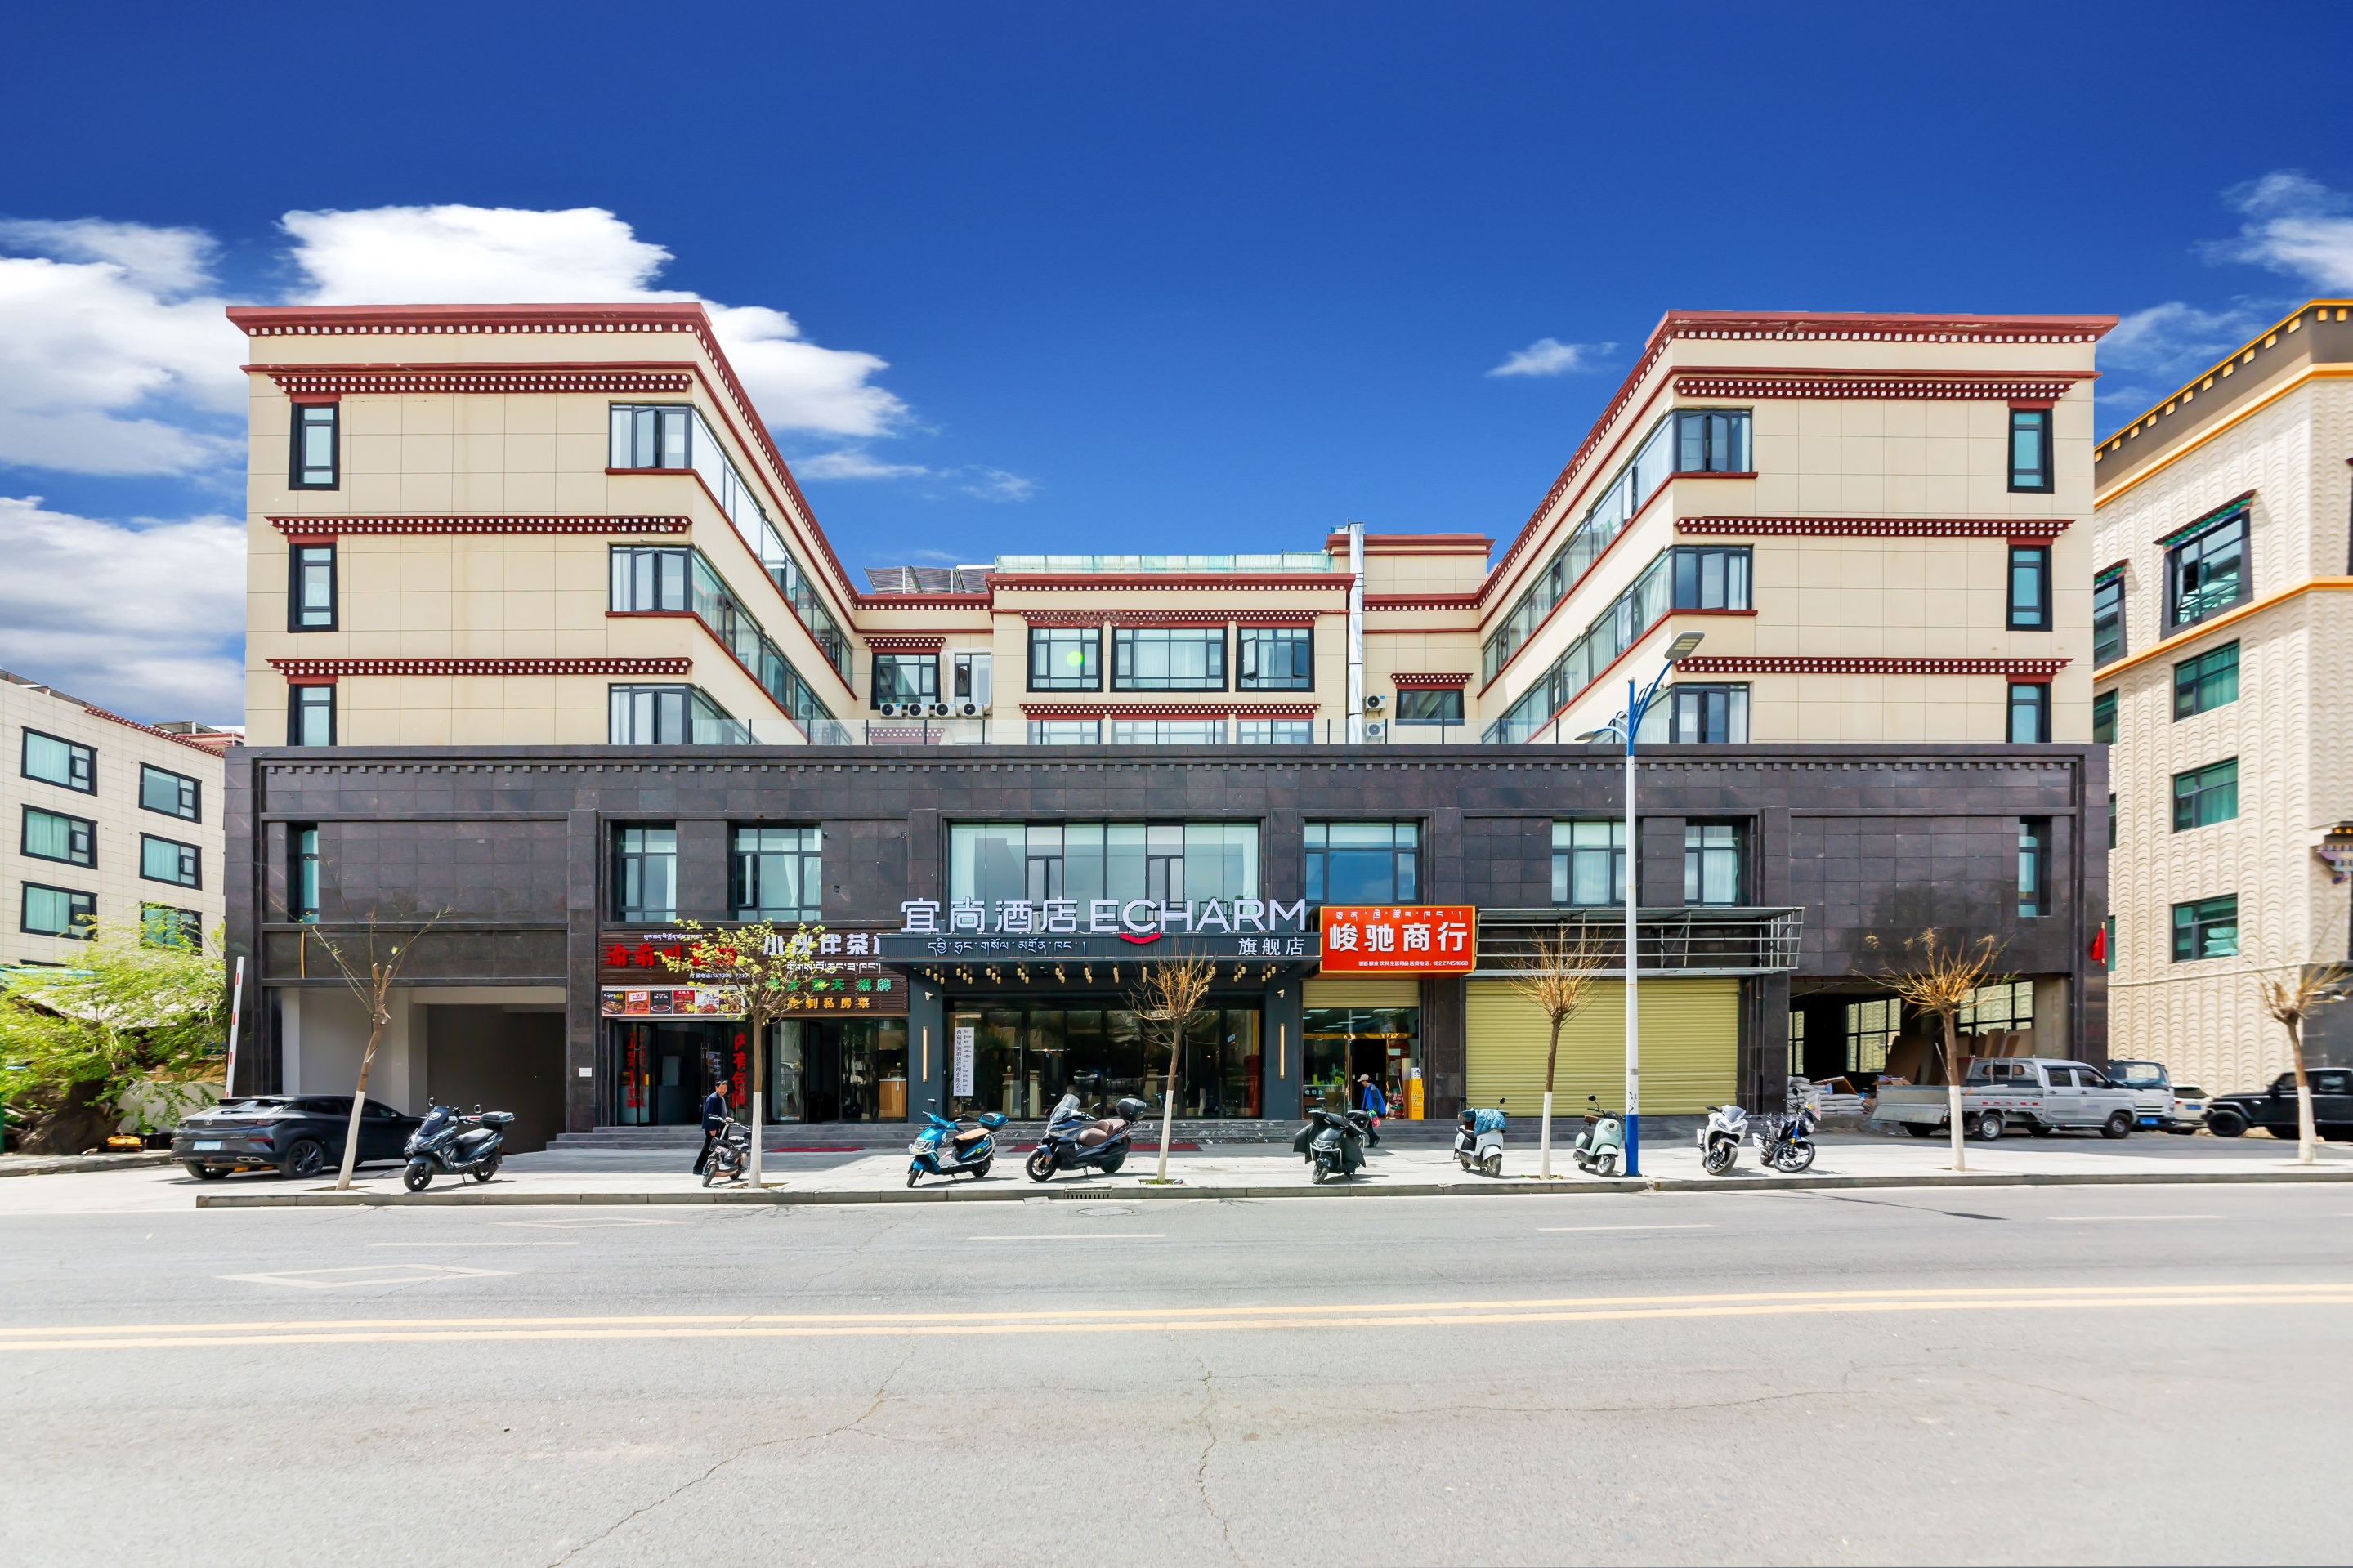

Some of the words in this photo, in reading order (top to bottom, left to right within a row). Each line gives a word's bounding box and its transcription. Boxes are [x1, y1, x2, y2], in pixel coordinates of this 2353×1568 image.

[901, 897, 1078, 933] 宜尚酒店
[1089, 898, 1305, 932] ECHARM
[762, 933, 880, 955] 小伙伴茶
[1238, 937, 1304, 956] 旗舰店
[1329, 922, 1468, 952] 峻驰商行
